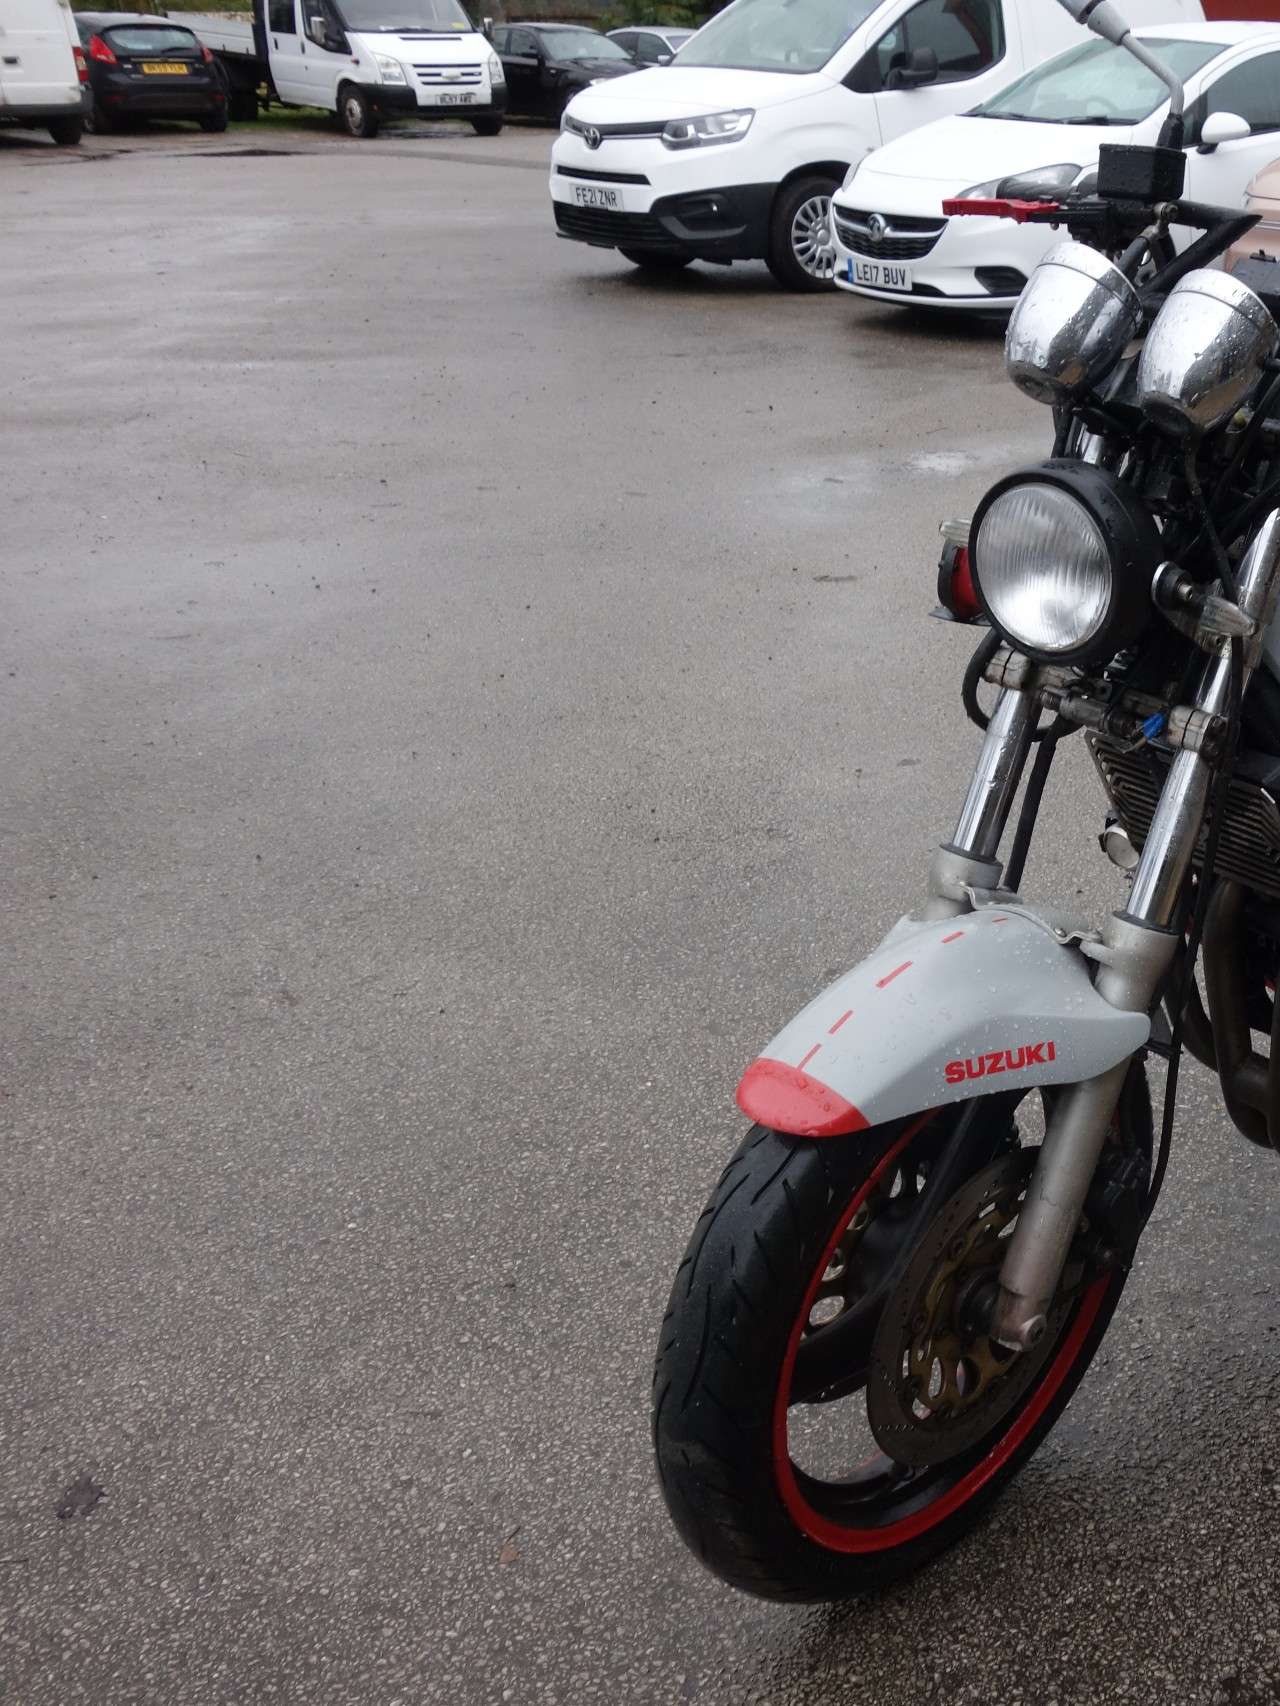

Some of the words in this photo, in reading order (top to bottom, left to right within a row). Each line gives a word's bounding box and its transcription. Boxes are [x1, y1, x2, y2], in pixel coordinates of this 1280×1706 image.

[575, 187, 597, 204] FE21
[856, 263, 879, 283] LE17
[883, 267, 906, 286] BUV
[944, 1040, 1056, 1084] SUZUKI
